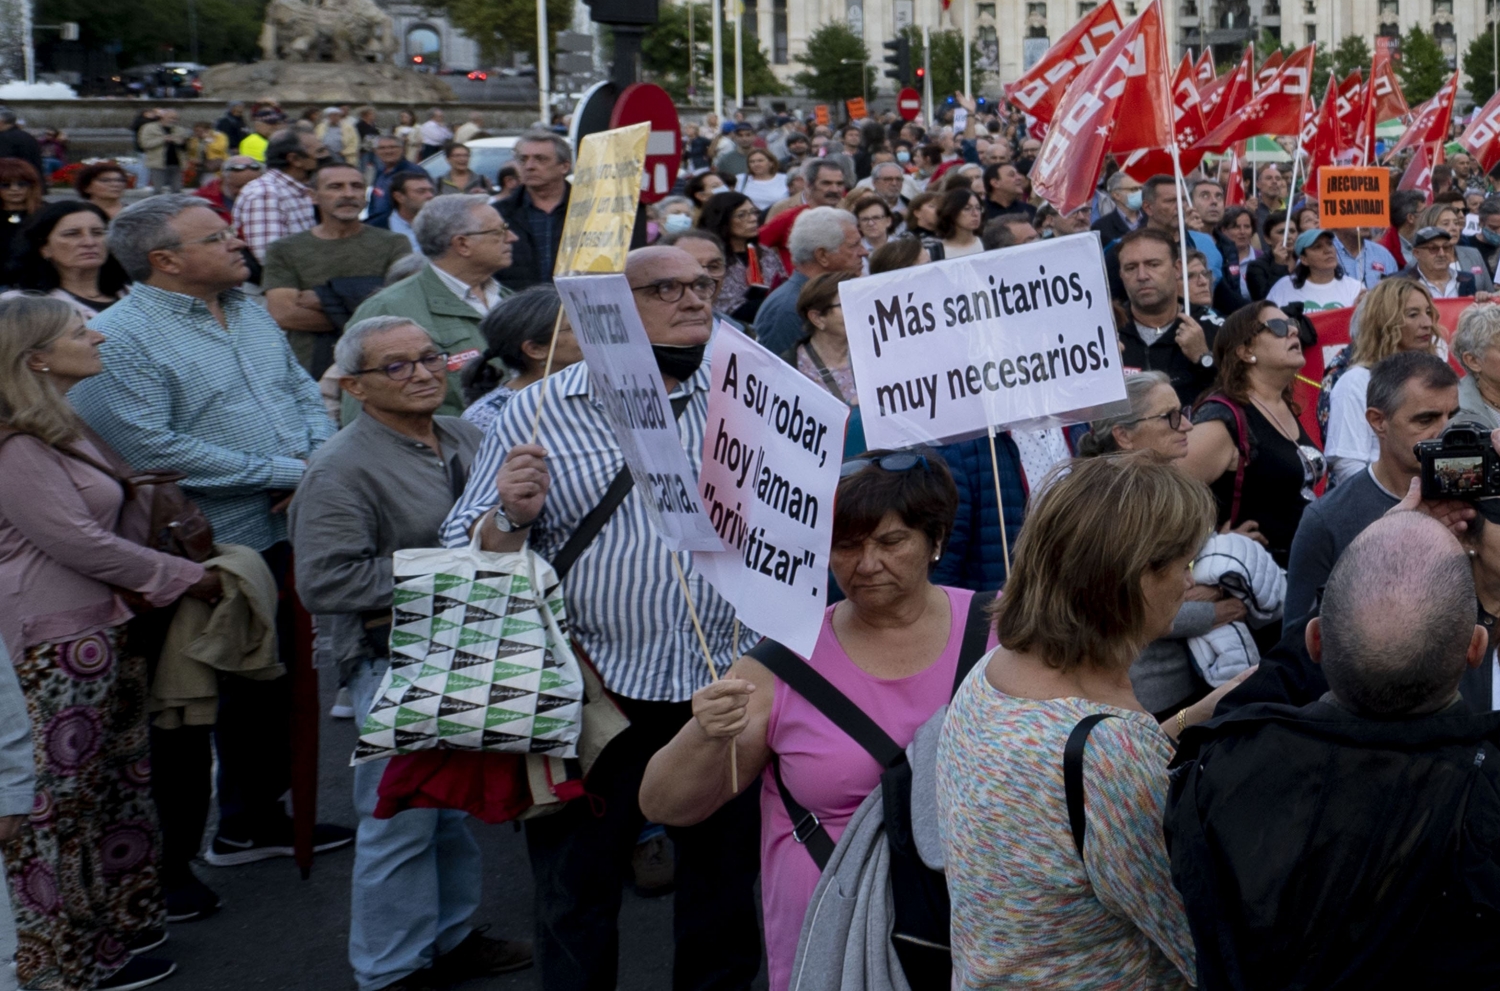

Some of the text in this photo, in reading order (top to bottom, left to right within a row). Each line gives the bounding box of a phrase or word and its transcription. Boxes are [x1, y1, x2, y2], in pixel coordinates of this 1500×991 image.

[1323, 198, 1384, 216] TU SANIDAD!
[1326, 175, 1380, 194] ¡RECUPERA
[868, 264, 1093, 358] ¡Más sanitarios,
[721, 353, 828, 468] A su robar,
[876, 325, 1109, 420] muy necesarios!
[713, 418, 819, 529] hoy llaman
[704, 482, 818, 597] "privtizar".
